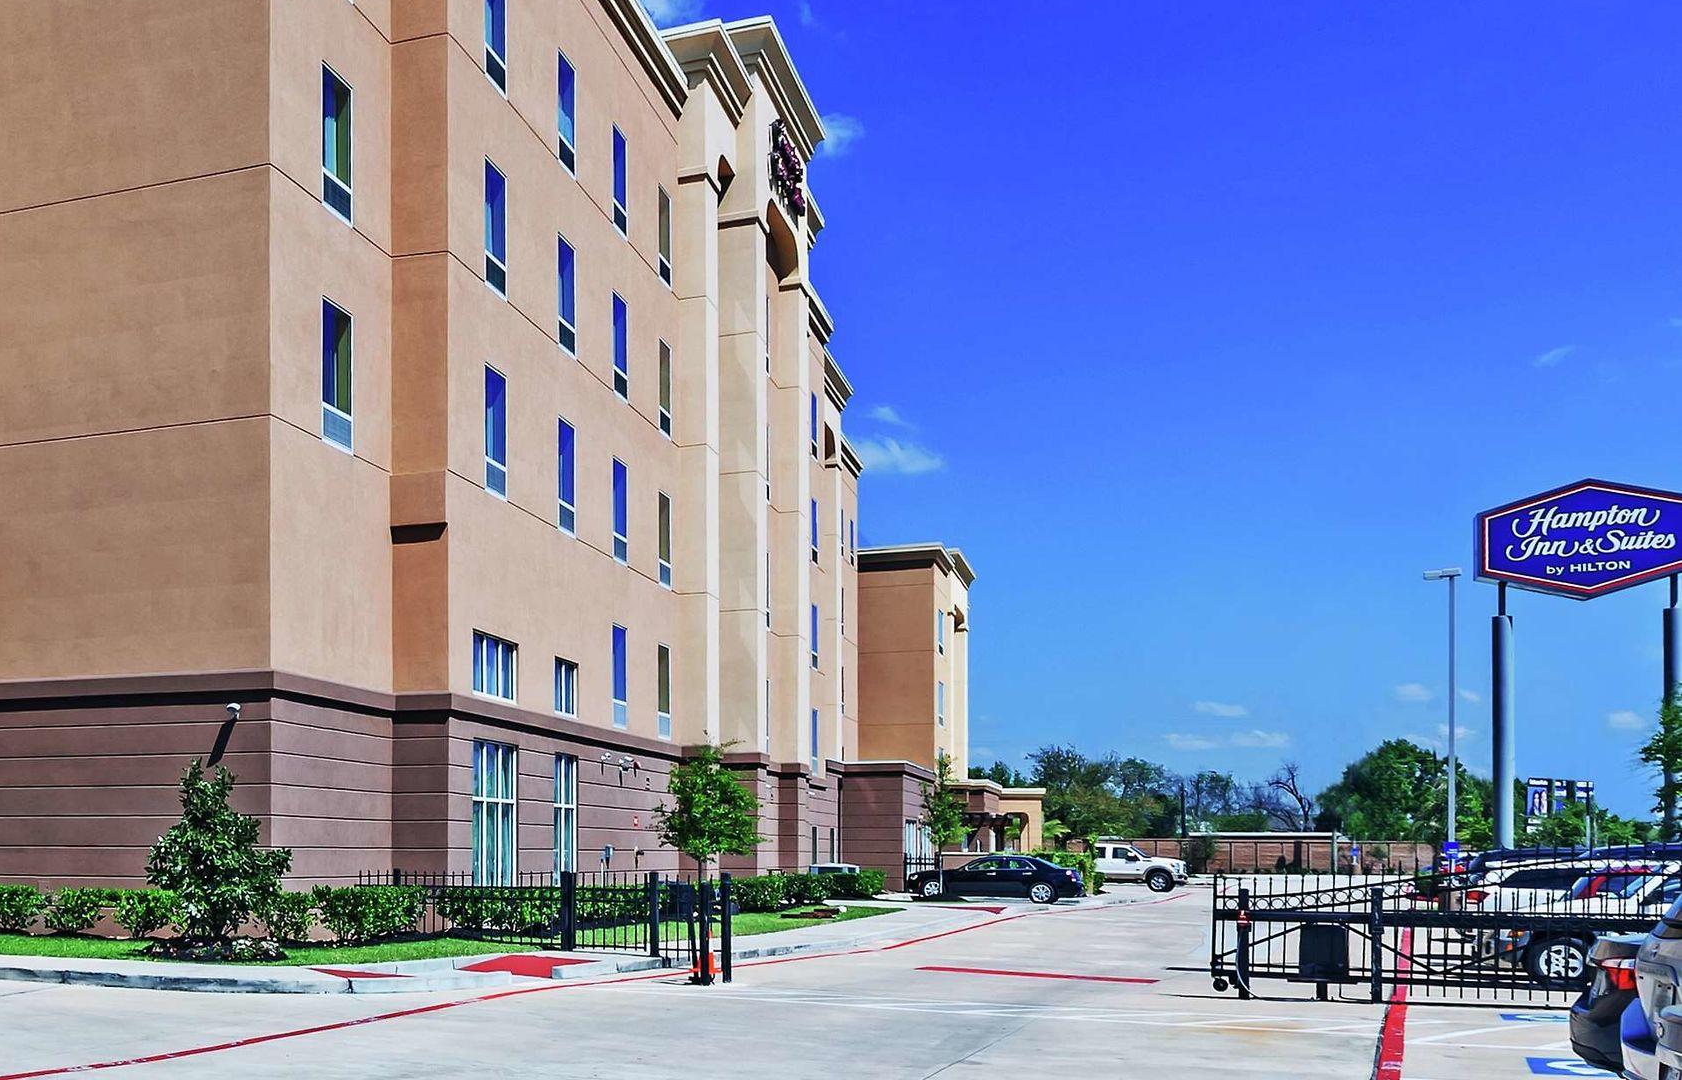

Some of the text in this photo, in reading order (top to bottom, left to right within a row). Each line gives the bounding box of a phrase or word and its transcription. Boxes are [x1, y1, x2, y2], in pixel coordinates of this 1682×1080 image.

[1512, 505, 1660, 538] Hampton
[1506, 530, 1676, 561] Inn & Suites
[1546, 561, 1630, 576] by HILTON
